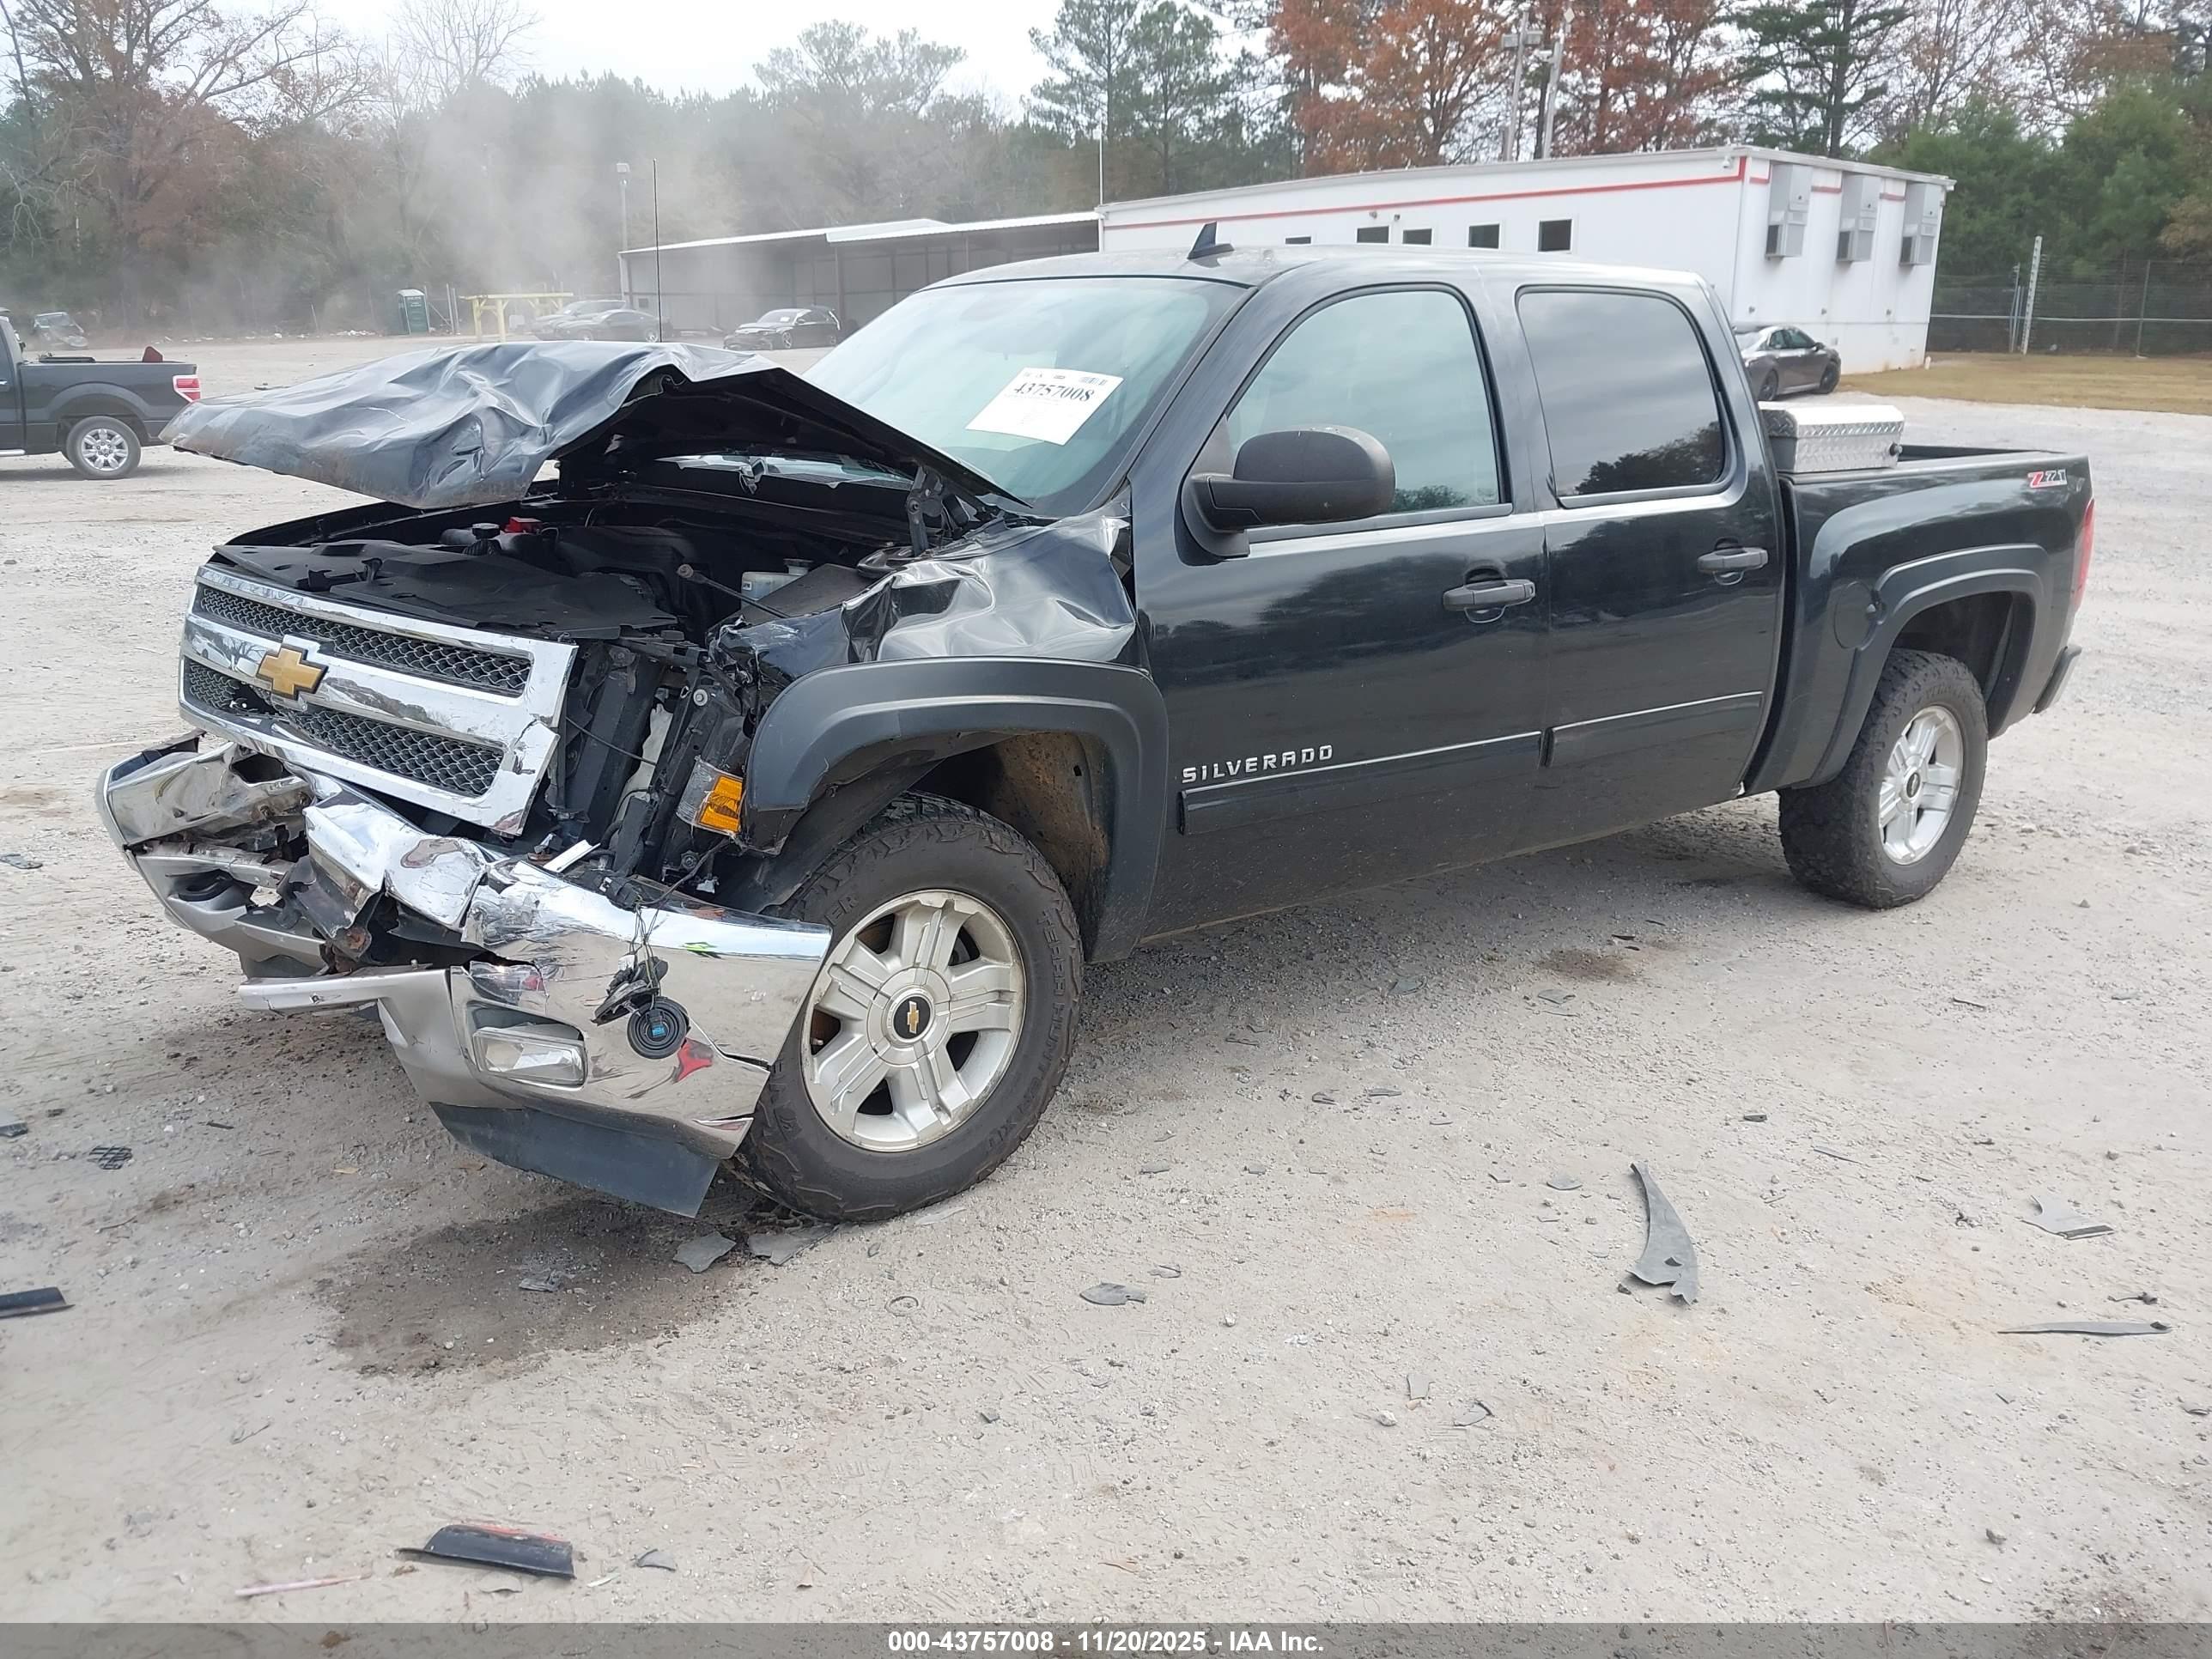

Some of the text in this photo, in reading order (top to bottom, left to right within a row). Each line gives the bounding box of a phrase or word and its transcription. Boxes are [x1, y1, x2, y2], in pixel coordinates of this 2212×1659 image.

[1013, 381, 1096, 402] 43757008
[2027, 469, 2068, 489] Z71
[1181, 744, 1334, 784] SILVERADO
[1036, 907, 1066, 997] TERRA
